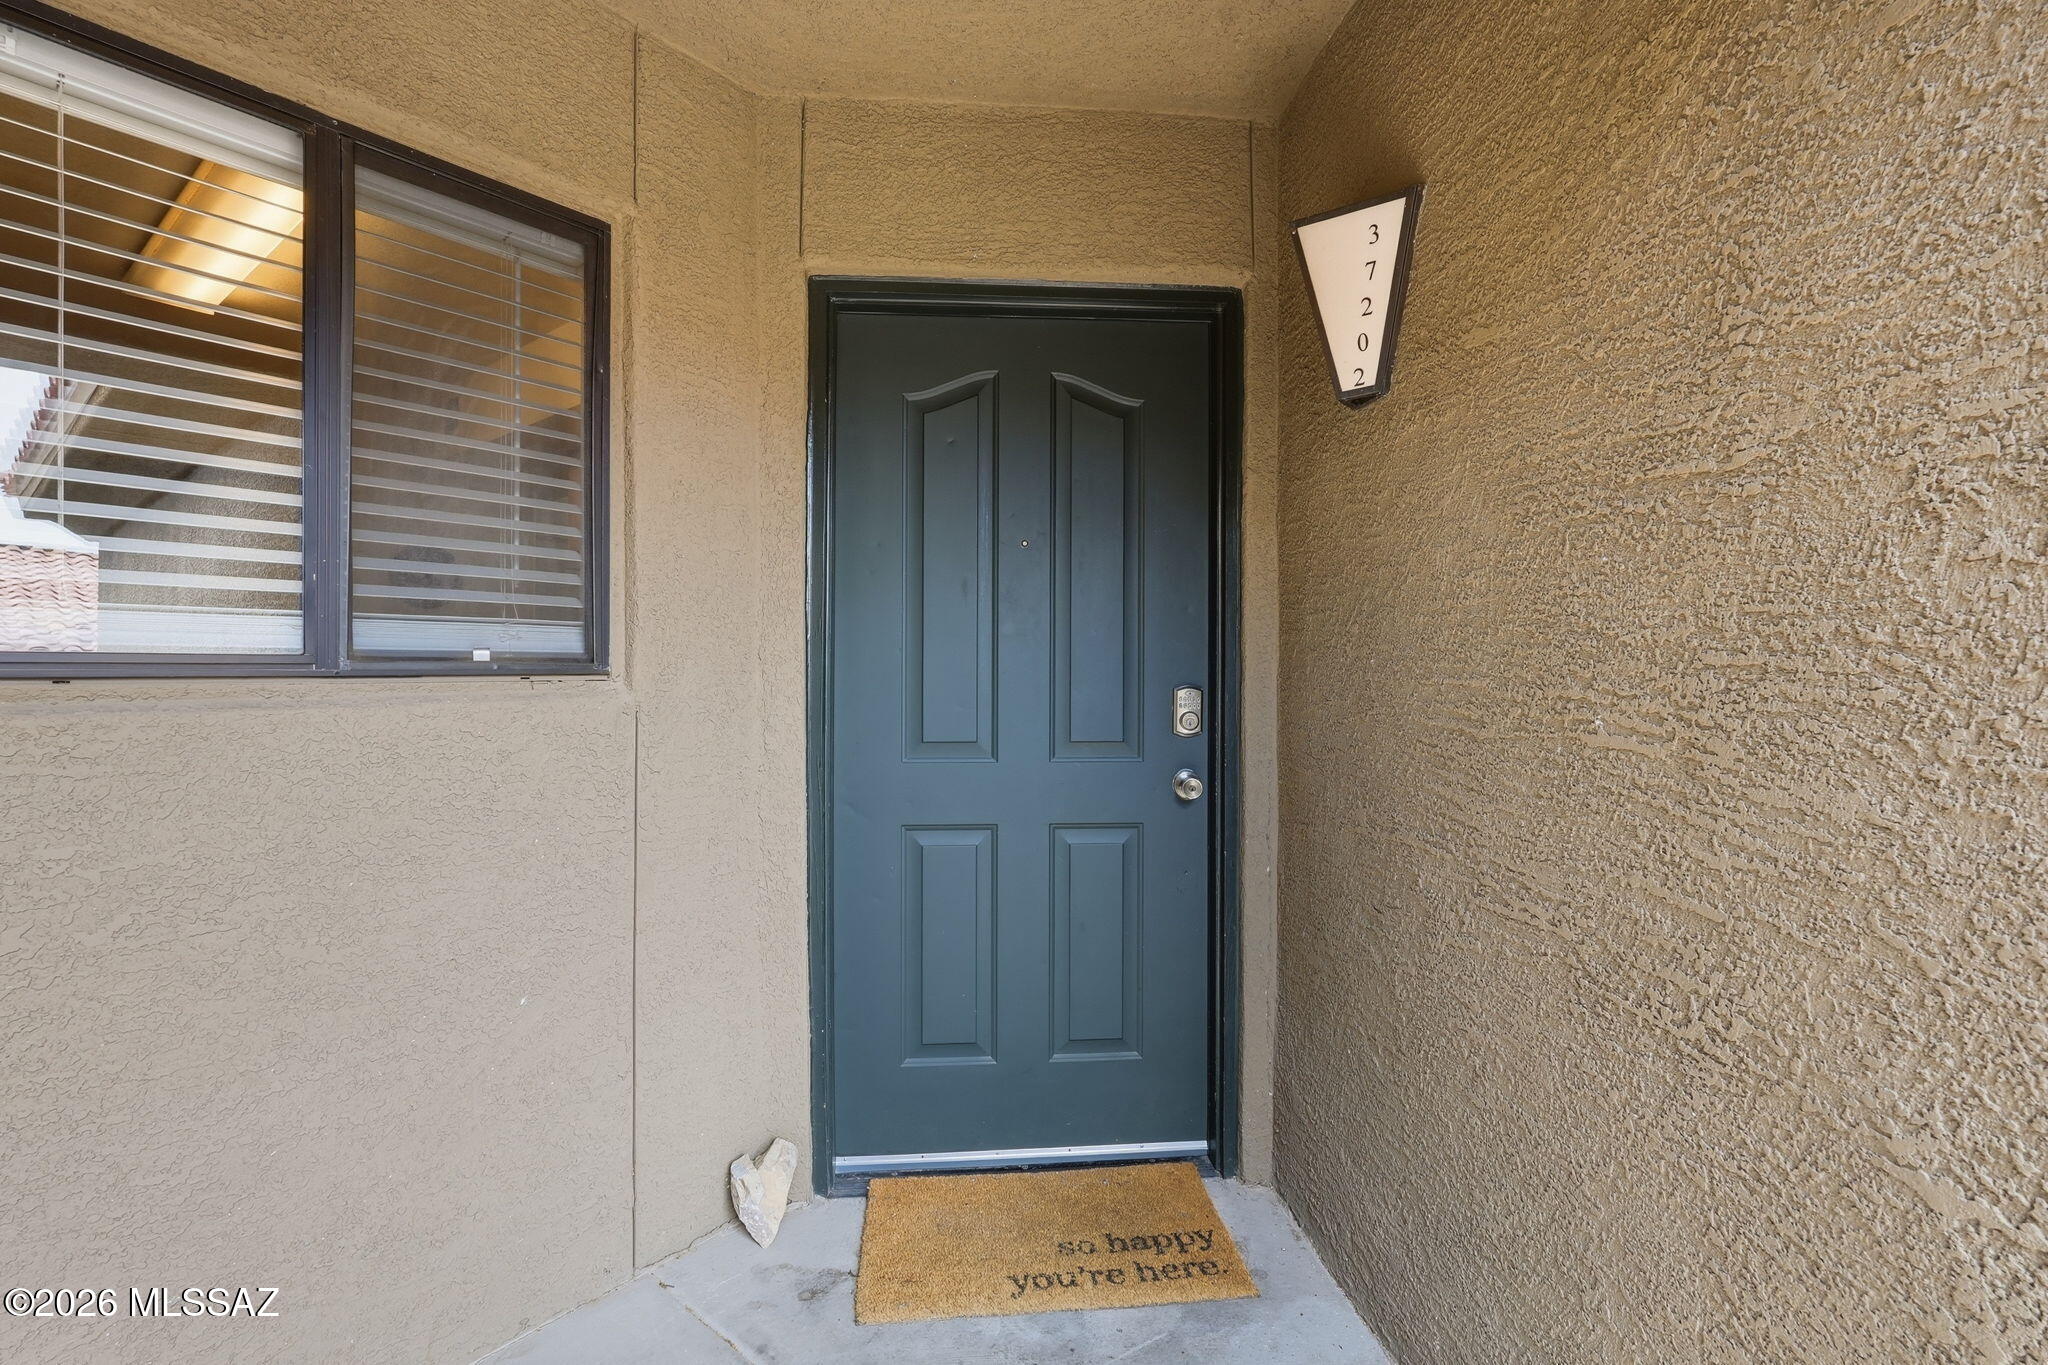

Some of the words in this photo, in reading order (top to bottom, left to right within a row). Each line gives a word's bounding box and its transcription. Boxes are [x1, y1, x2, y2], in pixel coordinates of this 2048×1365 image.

[1353, 224, 1379, 387] 37202
[1057, 1239, 1097, 1256] so
[1104, 1229, 1214, 1256] happy
[1007, 1266, 1126, 1300] you're
[1133, 1260, 1229, 1284] here.
